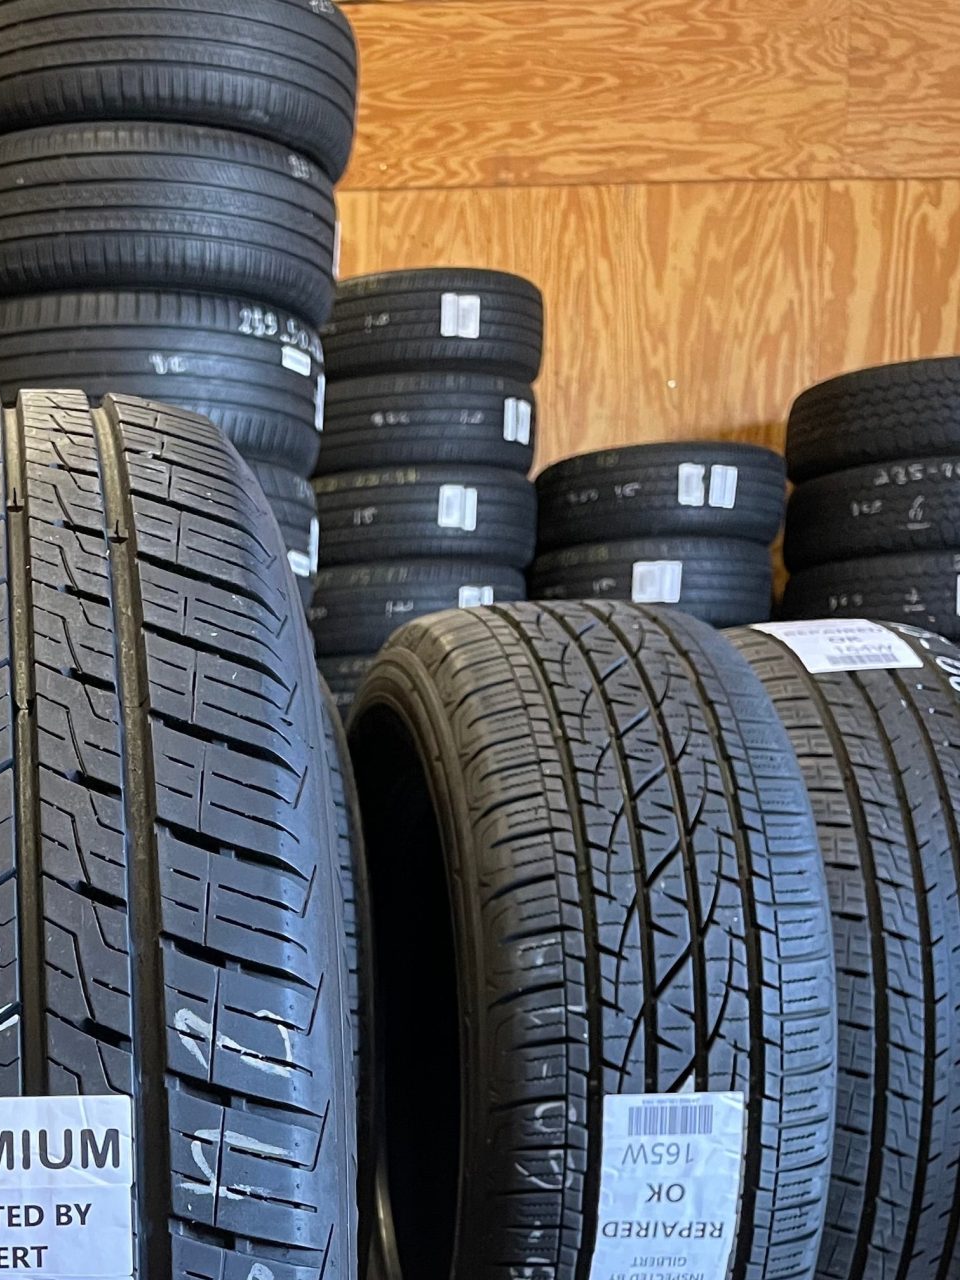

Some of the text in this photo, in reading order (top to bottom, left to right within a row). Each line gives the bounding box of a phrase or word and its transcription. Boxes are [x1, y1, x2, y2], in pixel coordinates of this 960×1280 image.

[621, 1142, 695, 1166] 165W
[646, 1183, 686, 1203] OK
[55, 1203, 93, 1226] BY
[602, 1220, 724, 1238] REPAIRED
[630, 1255, 688, 1268] GILBERT
